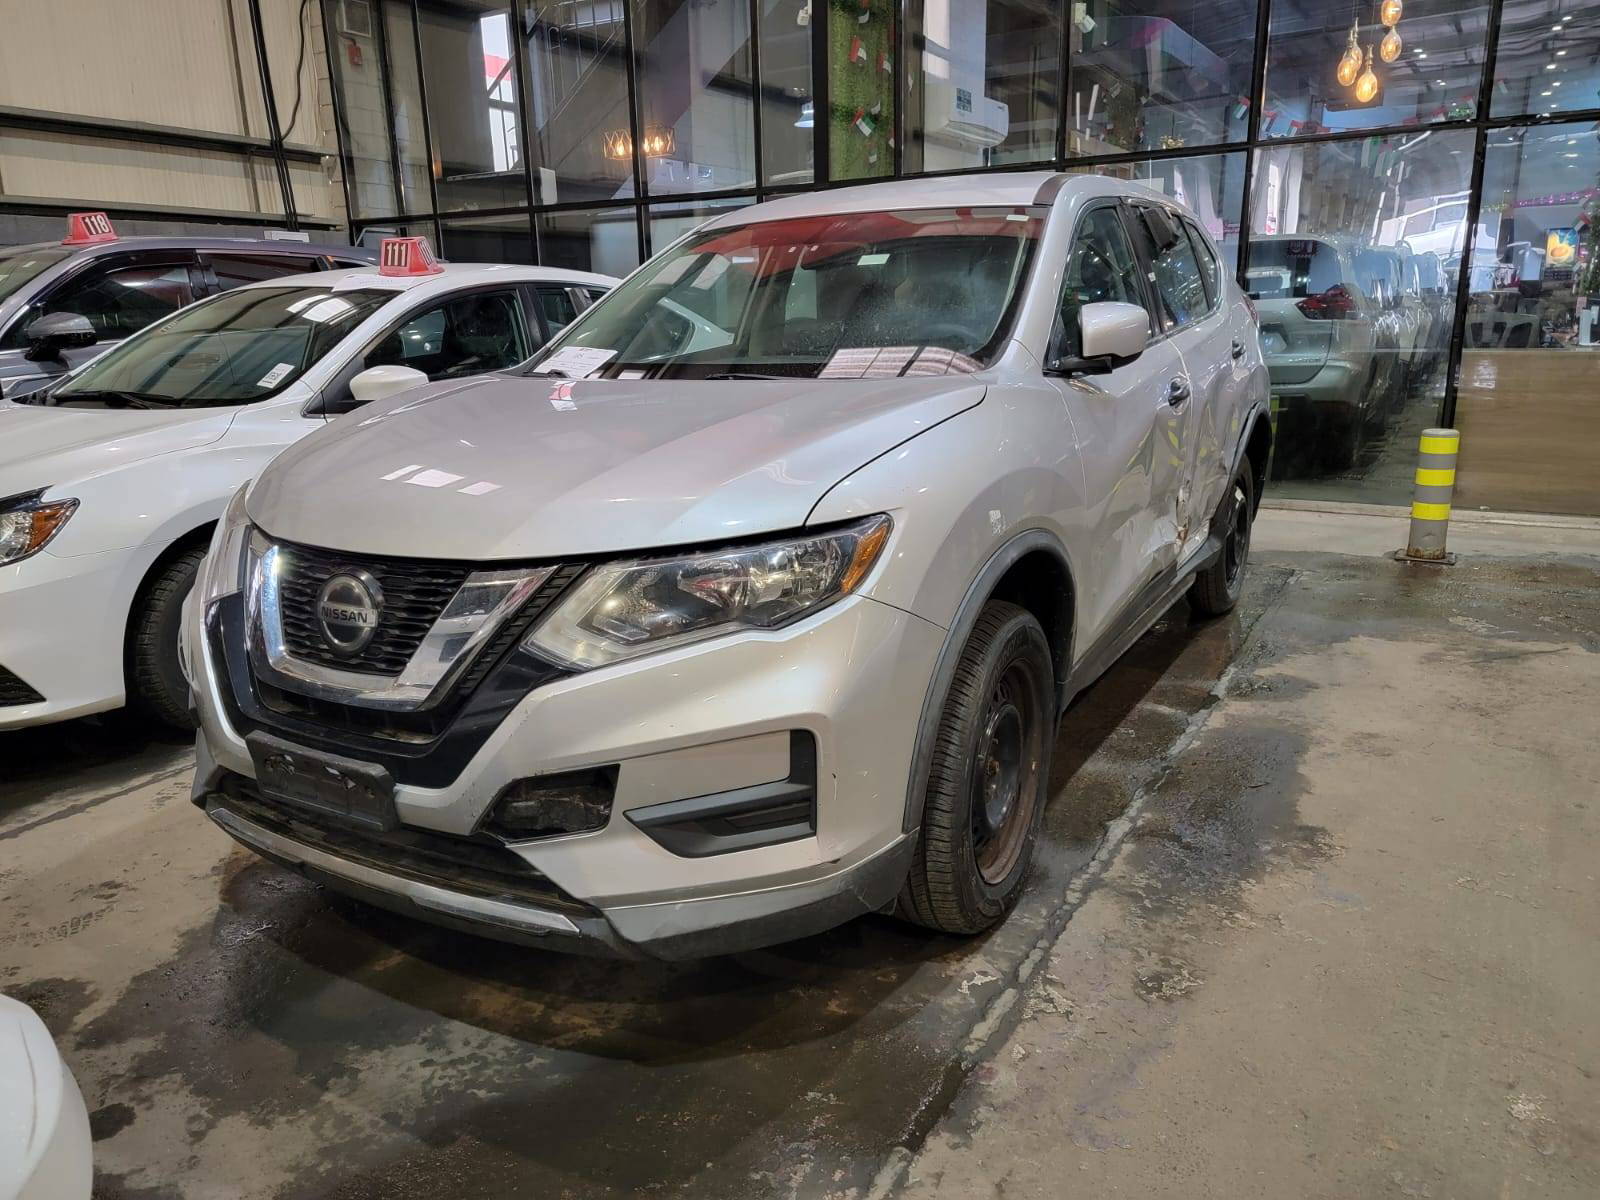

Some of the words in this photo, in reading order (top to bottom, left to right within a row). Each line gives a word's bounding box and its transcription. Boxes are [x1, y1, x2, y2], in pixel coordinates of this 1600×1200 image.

[84, 214, 110, 235] 118
[387, 243, 406, 266] 111
[321, 606, 368, 623] NISSAN
